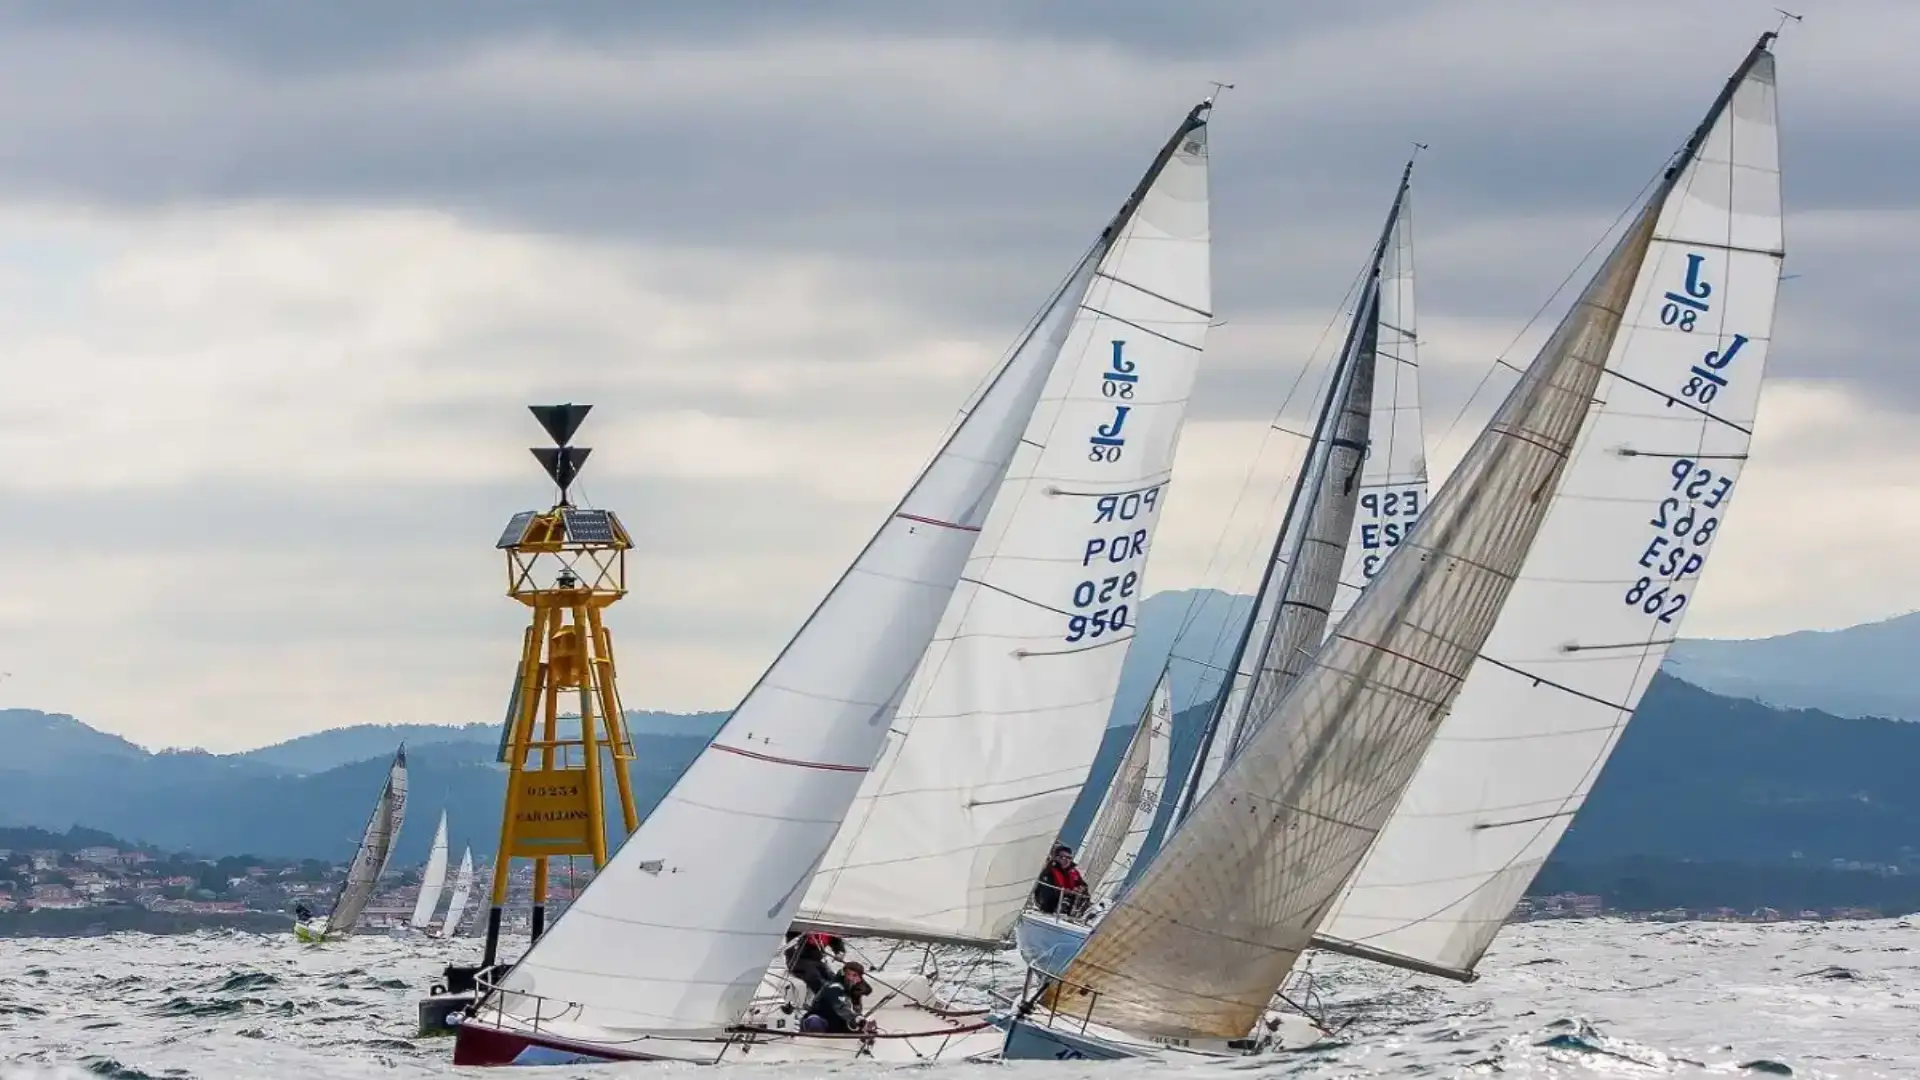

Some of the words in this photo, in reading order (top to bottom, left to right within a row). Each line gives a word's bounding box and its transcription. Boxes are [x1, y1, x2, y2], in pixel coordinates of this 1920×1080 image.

[1704, 333, 1748, 369] J
[1681, 376, 1718, 404] 80
[1098, 406, 1131, 437] J
[1088, 445, 1121, 463] 80
[1083, 528, 1147, 566] POR
[1638, 536, 1703, 582] ESP
[1625, 576, 1686, 623] 862
[1065, 604, 1128, 642] 950
